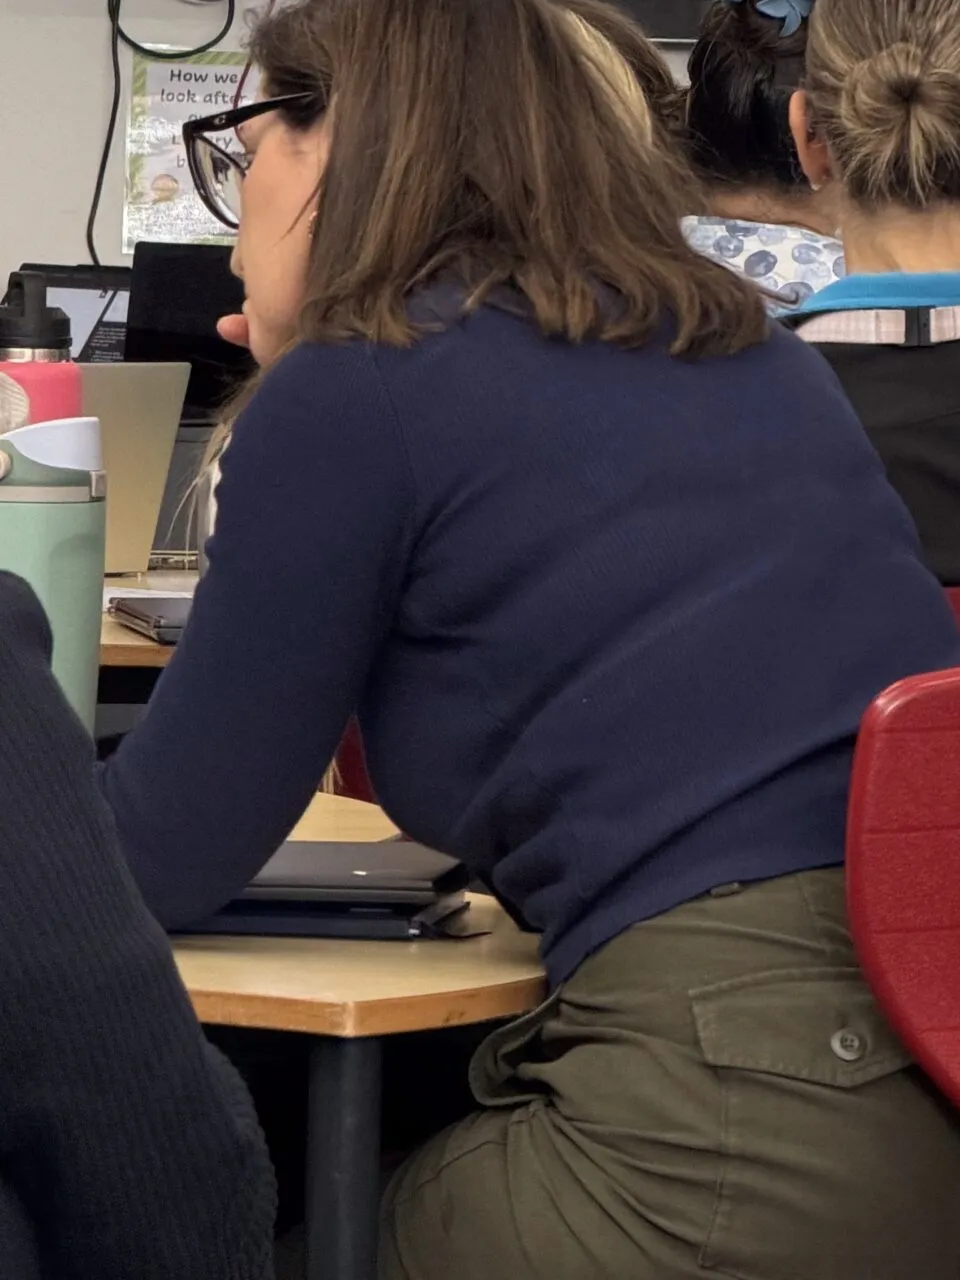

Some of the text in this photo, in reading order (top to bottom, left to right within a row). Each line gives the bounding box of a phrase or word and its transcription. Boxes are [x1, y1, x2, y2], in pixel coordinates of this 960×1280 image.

[170, 70, 239, 84] How we
[161, 88, 197, 103] look
